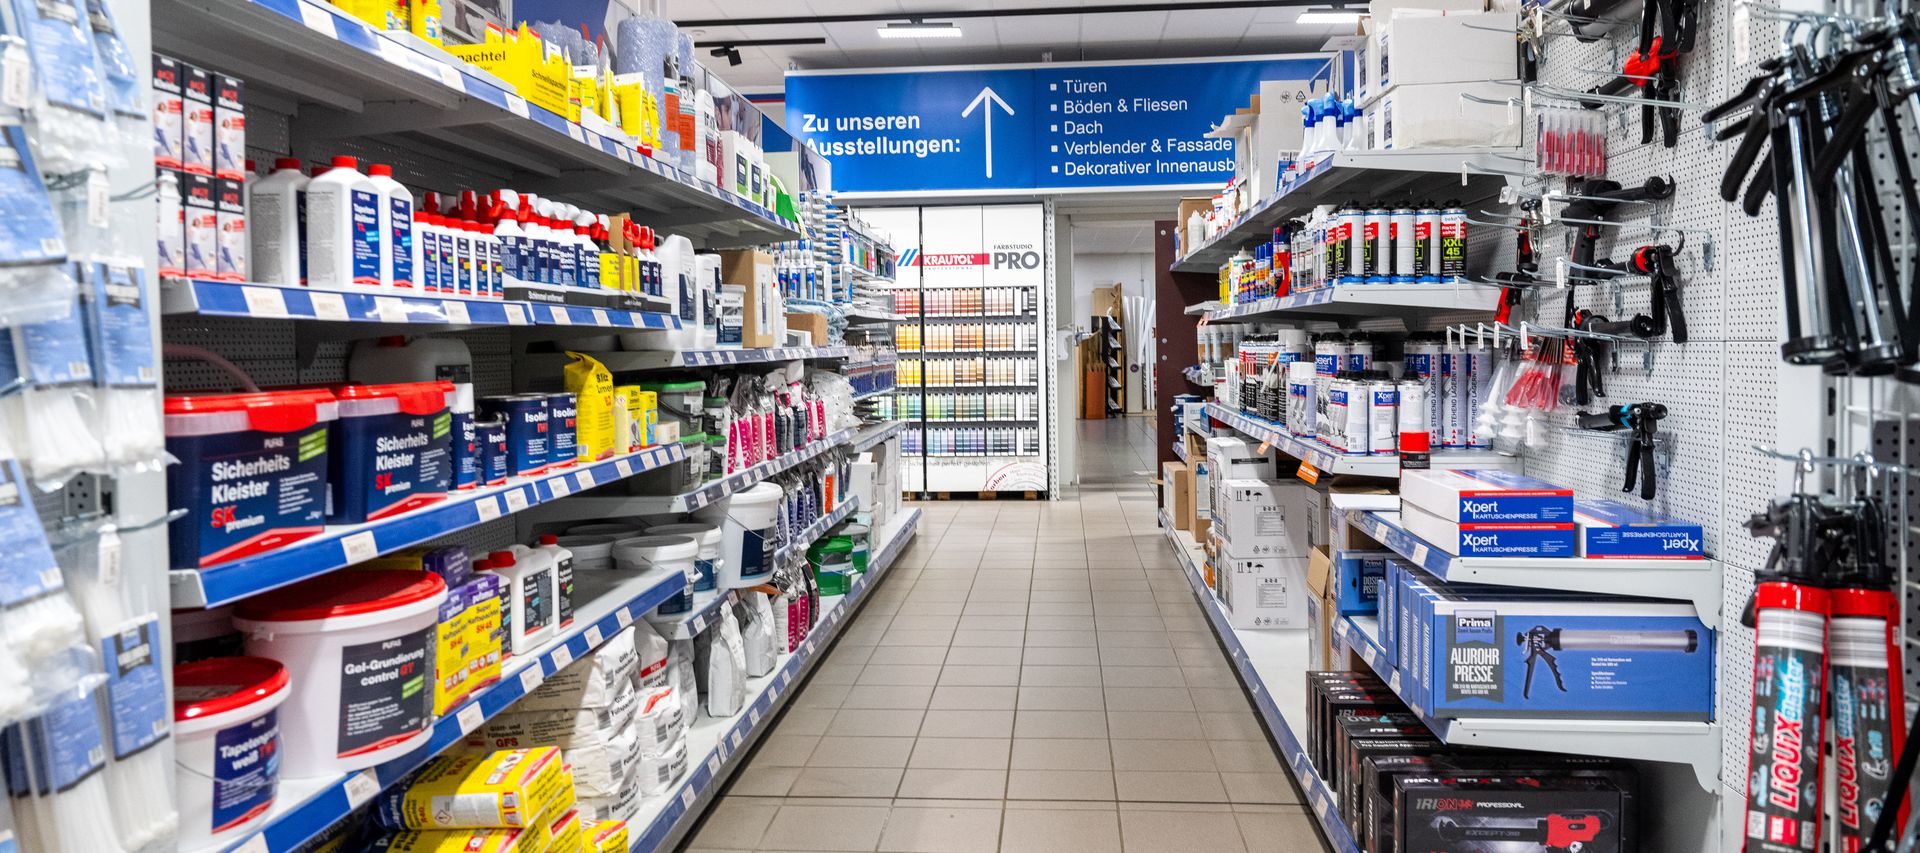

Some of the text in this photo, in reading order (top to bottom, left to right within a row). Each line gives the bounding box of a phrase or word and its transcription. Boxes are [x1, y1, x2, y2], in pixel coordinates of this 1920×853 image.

[1063, 79, 1107, 94] Türen
[1063, 96, 1188, 113] Böden & Fliesen
[802, 113, 920, 133] Zu unseren
[1064, 119, 1103, 134] Dach
[805, 134, 961, 158] Ausstellungen:
[1064, 136, 1233, 154] Verblender & Fassade
[1064, 157, 1235, 177] Dekorativer Innenausb
[1443, 238, 1464, 247] XXL
[1446, 247, 1460, 256] 45
[993, 250, 1041, 270] PRO
[376, 432, 428, 453] Sicherheits
[211, 455, 290, 481] Sicherheits
[376, 453, 415, 471] Kleister
[375, 472, 393, 490] SK
[385, 480, 411, 495] premium
[990, 473, 1007, 491] arben
[211, 480, 270, 504] Kleister
[211, 505, 237, 528] SK
[1463, 500, 1498, 519] Xpert
[226, 515, 265, 534] premium
[1463, 534, 1498, 552] Xpert
[1663, 532, 1699, 552] Xpert
[1459, 618, 1492, 627] Prima
[345, 648, 424, 675] Gel-Grundierung
[1450, 648, 1499, 665] ALUROHR
[361, 668, 399, 686] control
[1454, 665, 1493, 682] PRESSE
[496, 737, 519, 748] GFS
[232, 750, 259, 770] weiß
[1770, 708, 1803, 812] LiQUiX
[1416, 798, 1458, 810] IRION
